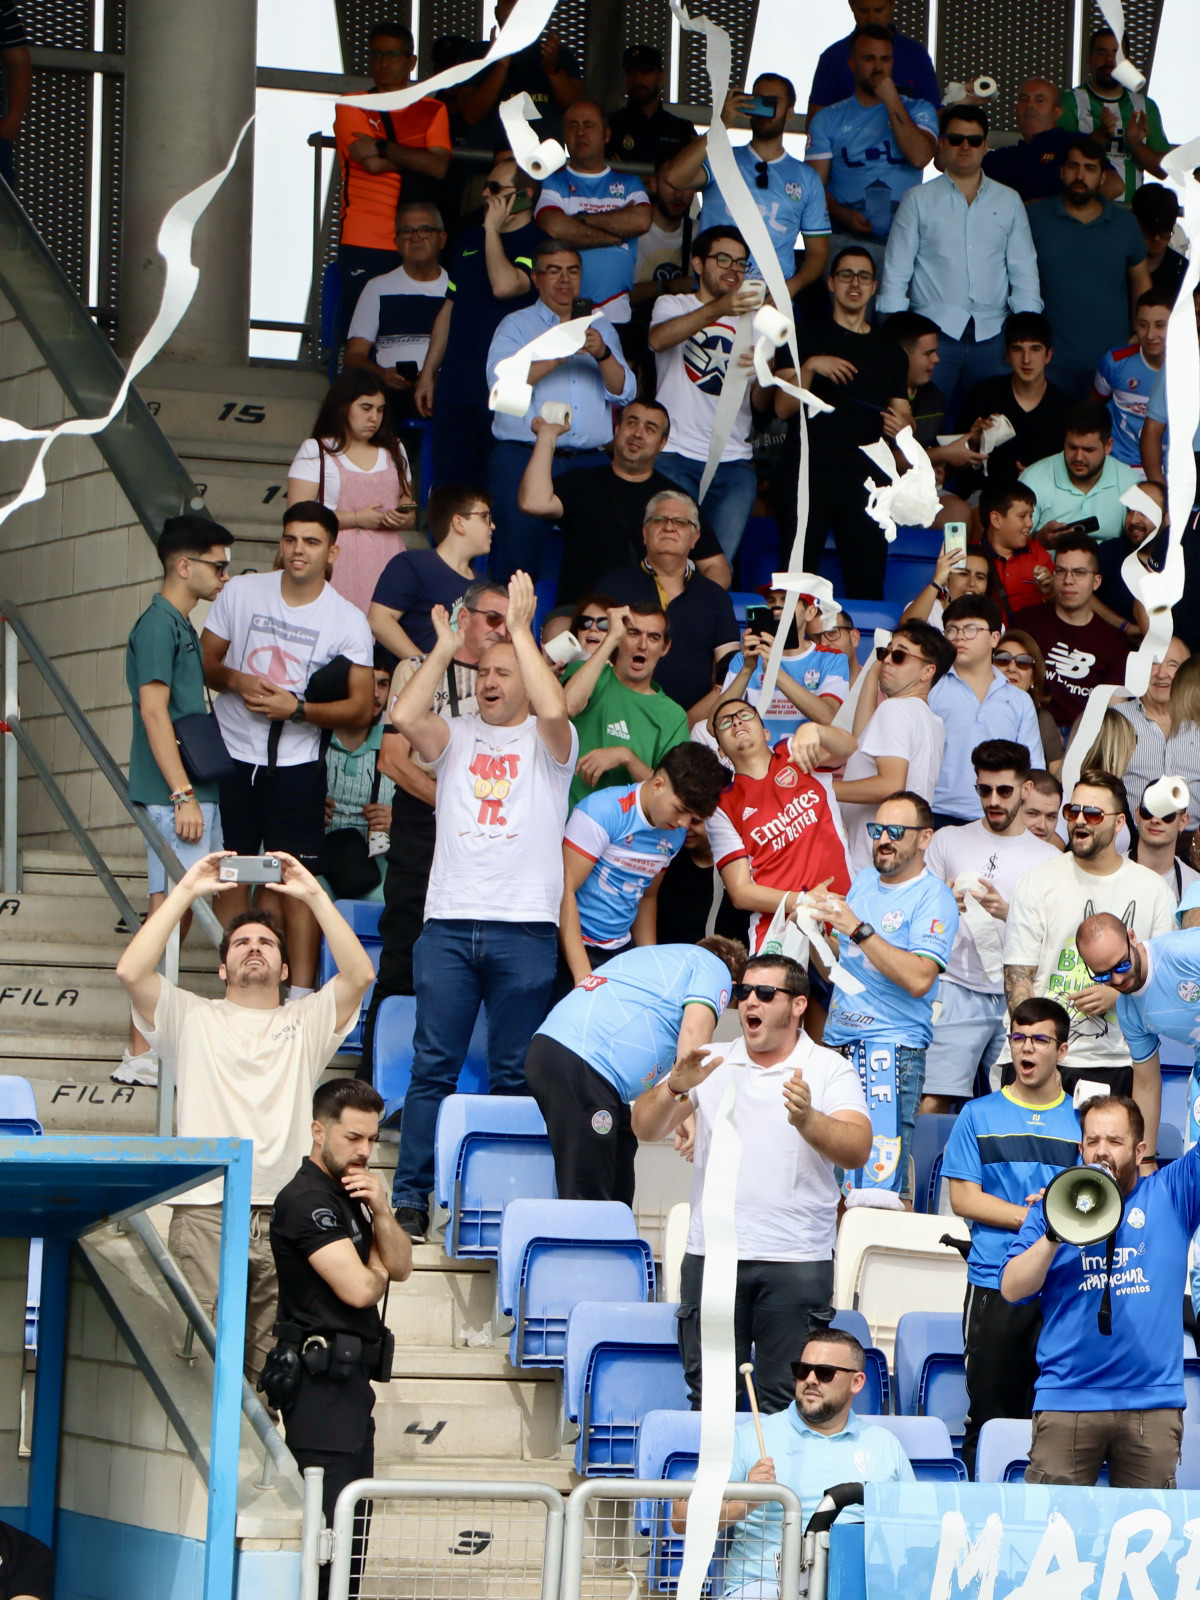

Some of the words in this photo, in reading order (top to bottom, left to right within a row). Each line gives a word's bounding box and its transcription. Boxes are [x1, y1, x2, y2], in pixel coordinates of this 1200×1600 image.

[218, 403, 266, 424] 15
[262, 486, 288, 504] 1
[249, 615, 318, 644] Champion
[469, 754, 519, 780] JUST
[474, 779, 512, 800] DO
[477, 799, 508, 826] IT.
[750, 790, 820, 846] Emirates
[786, 808, 818, 842] BETTER
[0, 988, 79, 1006] FILA
[870, 1050, 892, 1110] C.F.
[51, 1085, 135, 1104] FILA
[1116, 1284, 1150, 1296] eventos
[403, 1421, 445, 1445] 4
[448, 1530, 494, 1557] 3
